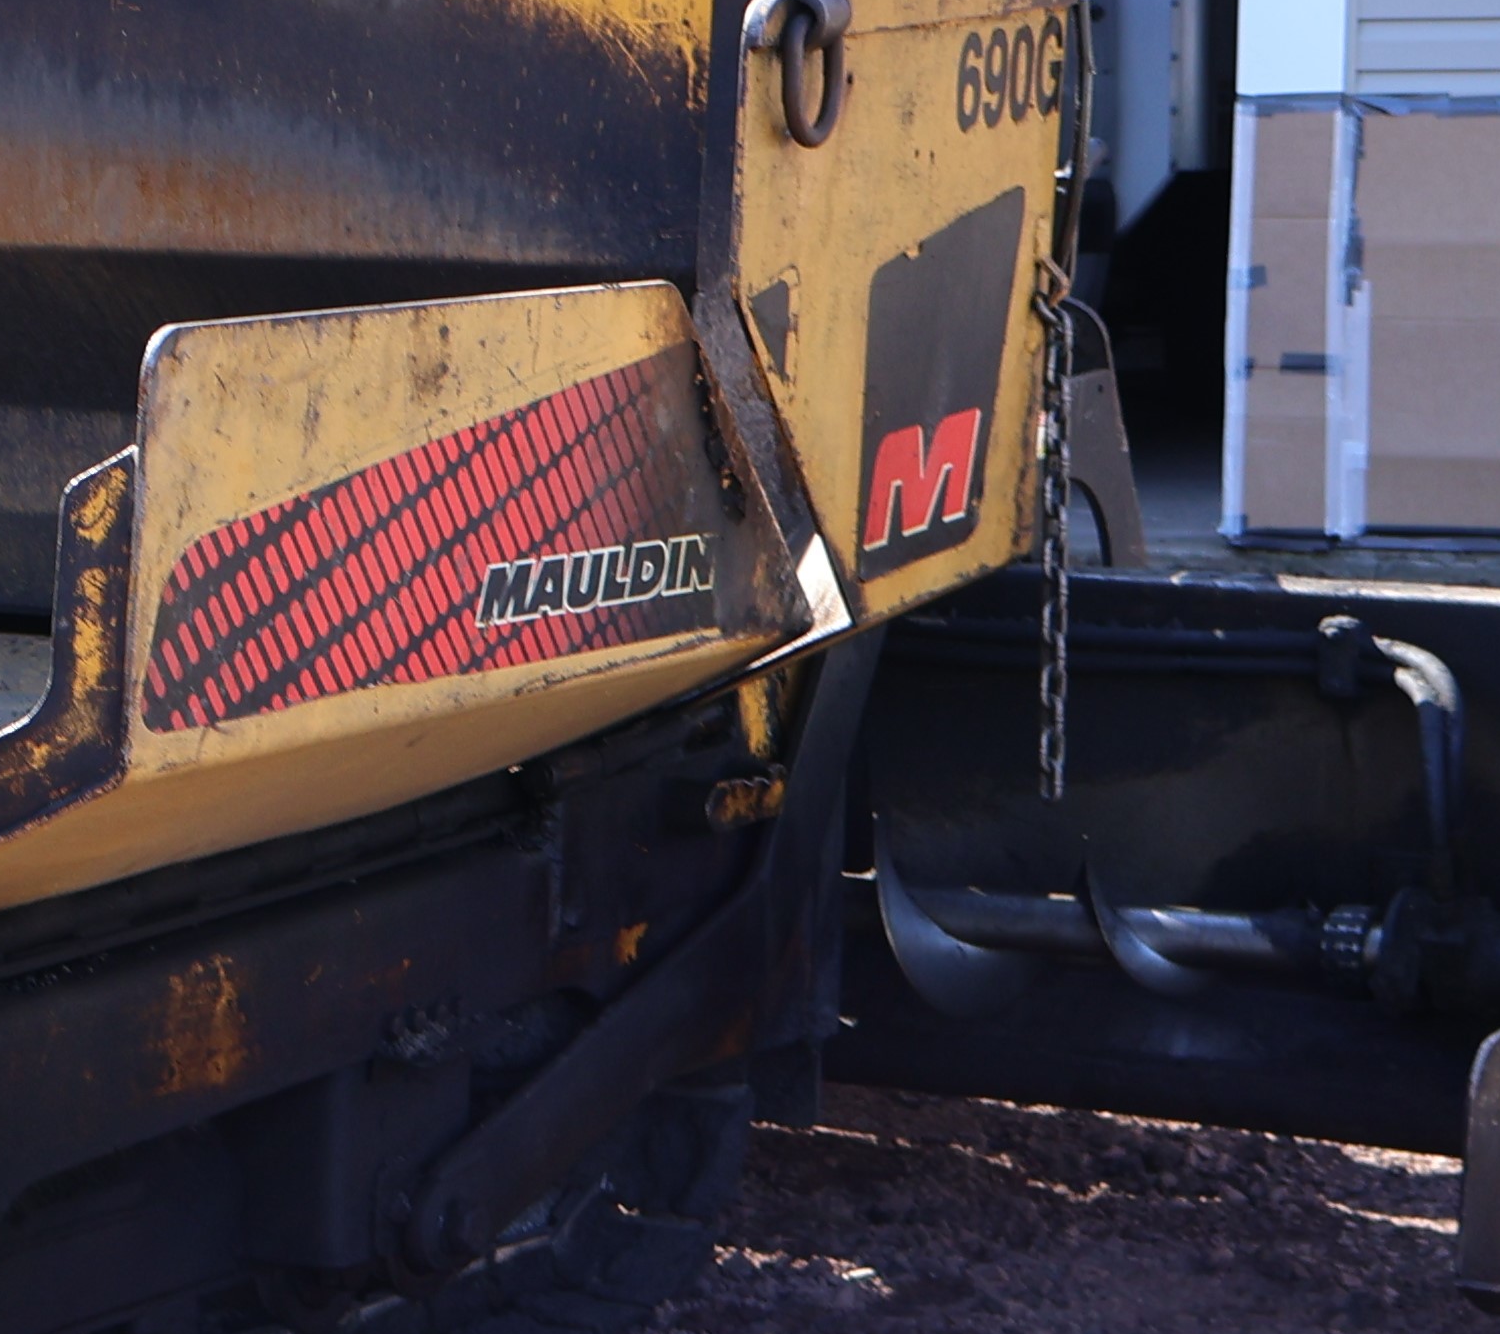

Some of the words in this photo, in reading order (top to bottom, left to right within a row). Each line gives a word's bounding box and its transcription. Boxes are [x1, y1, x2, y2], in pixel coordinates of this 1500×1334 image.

[957, 14, 1064, 134] 690G
[863, 407, 982, 552] M
[475, 533, 716, 628] MAULDIN
